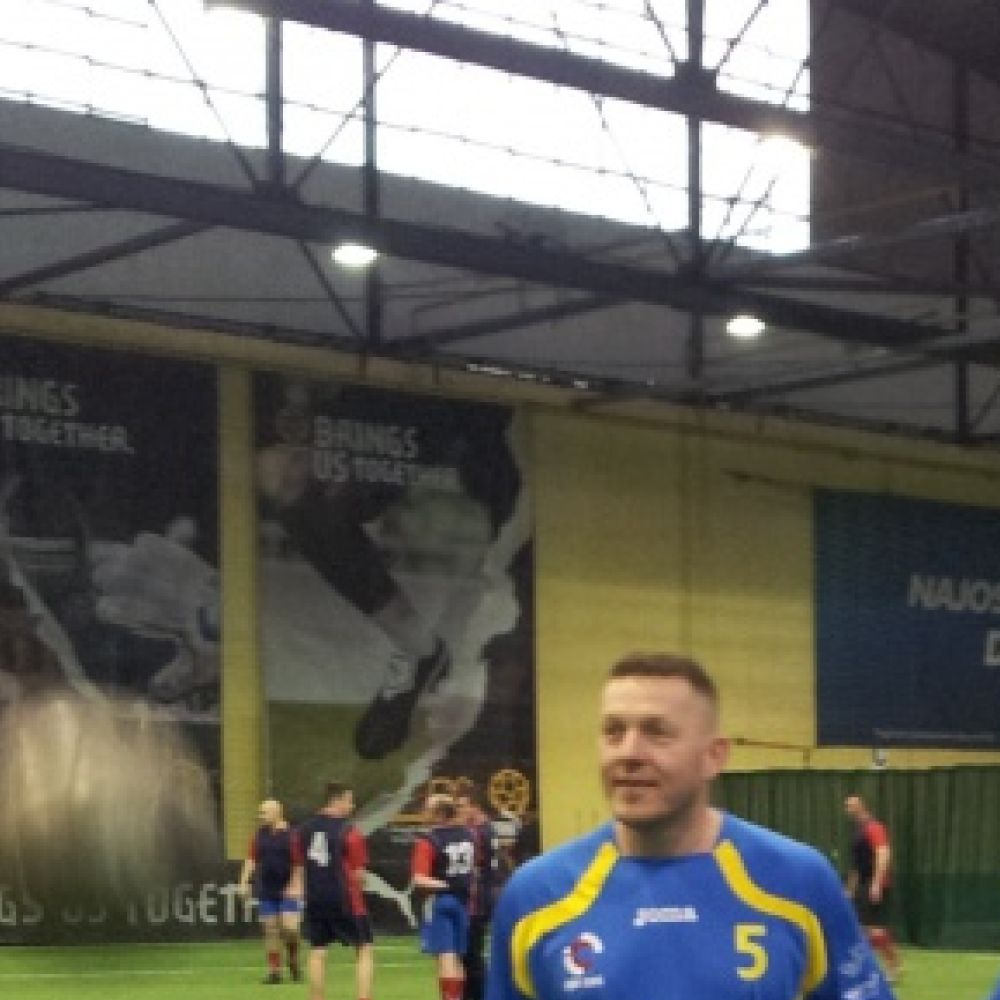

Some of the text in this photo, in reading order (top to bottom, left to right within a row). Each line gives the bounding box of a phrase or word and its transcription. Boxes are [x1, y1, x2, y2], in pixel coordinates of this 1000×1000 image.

[313, 450, 349, 483] US
[307, 831, 329, 868] 4
[734, 924, 768, 981] 5
